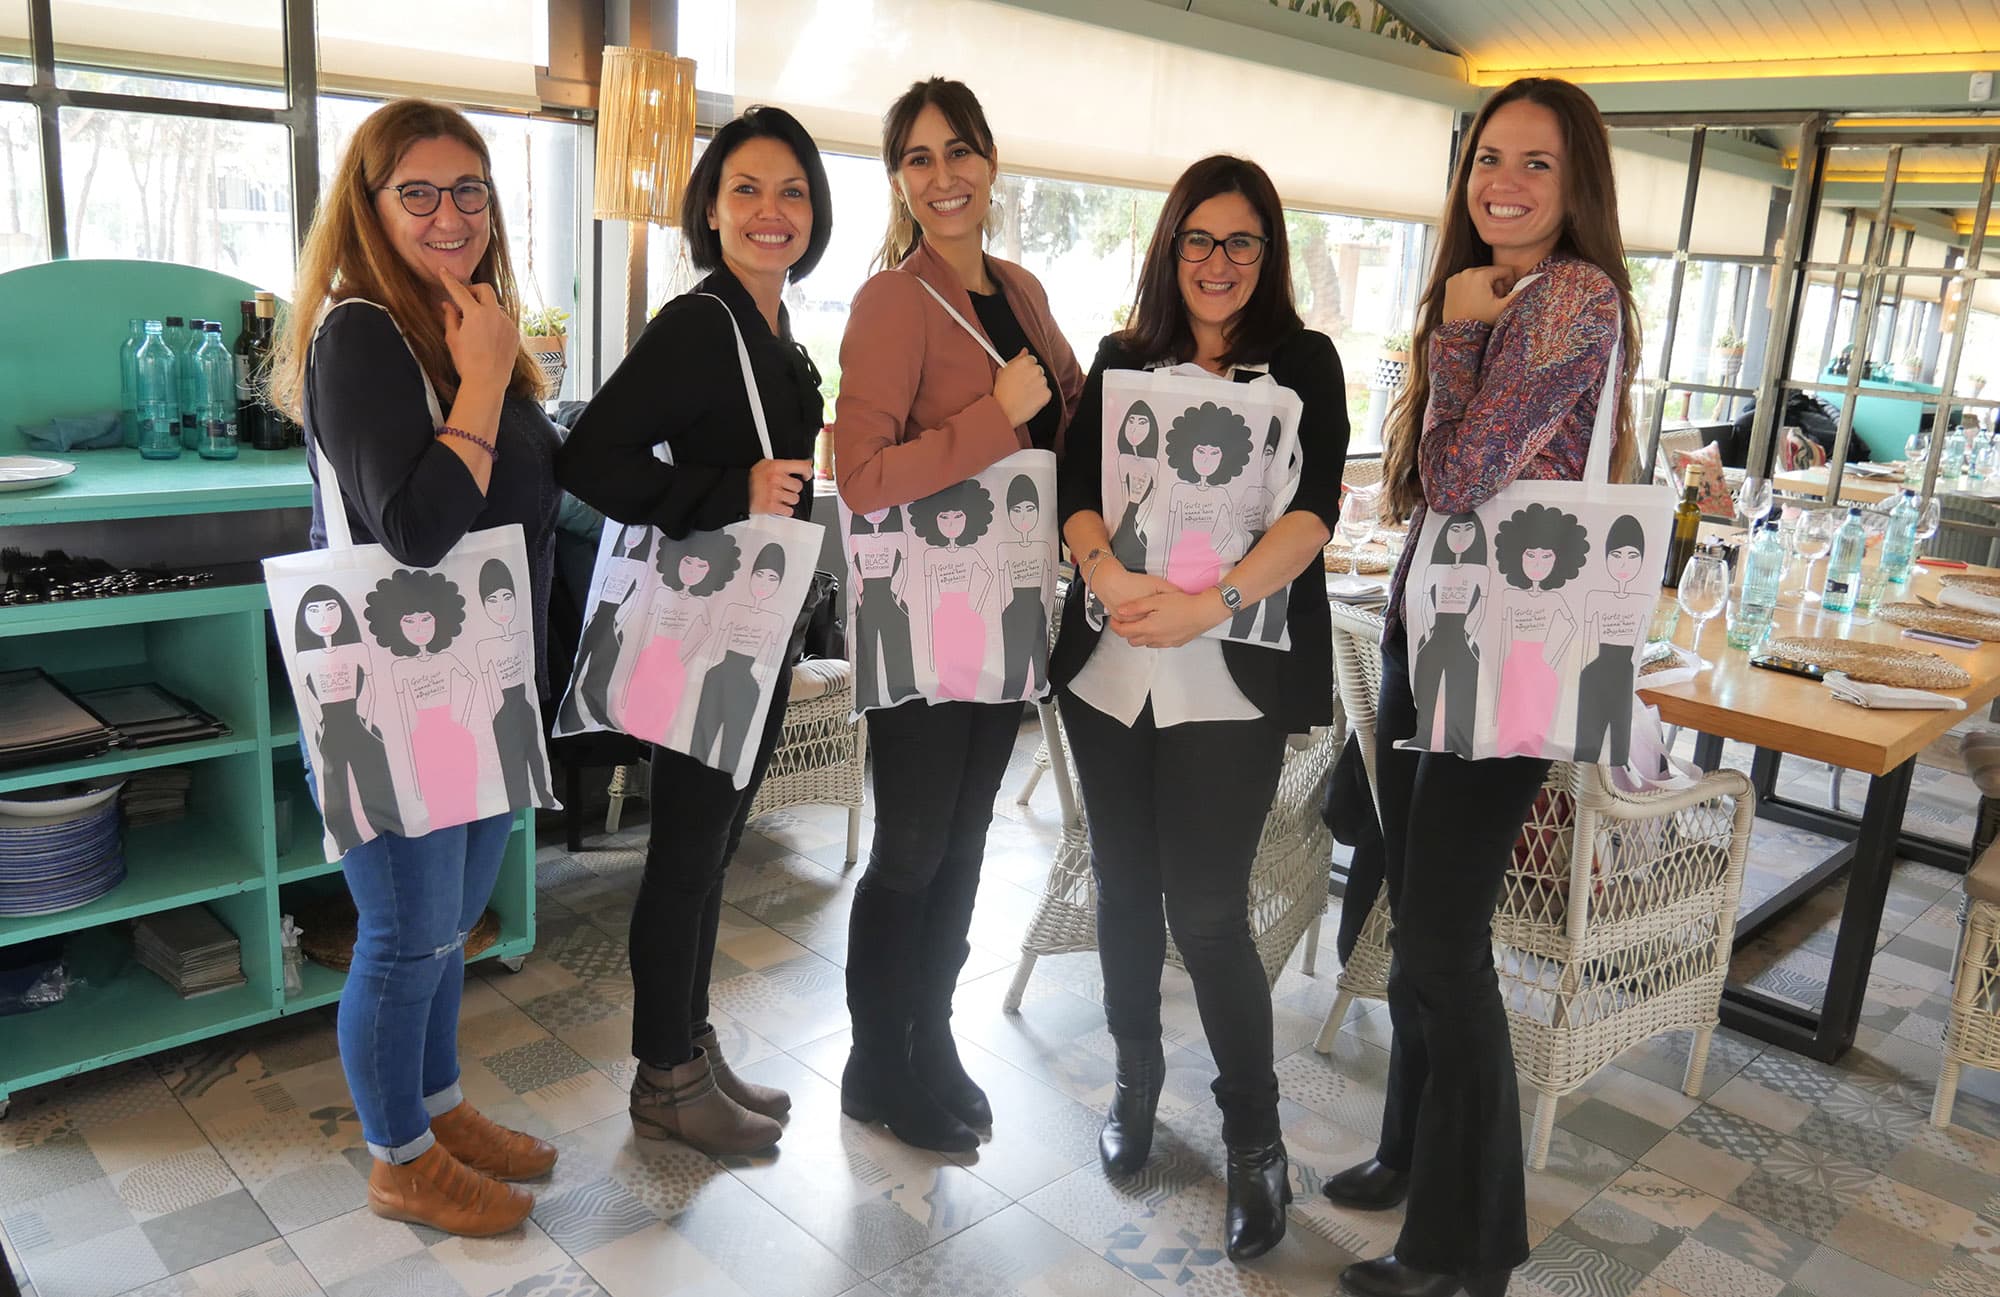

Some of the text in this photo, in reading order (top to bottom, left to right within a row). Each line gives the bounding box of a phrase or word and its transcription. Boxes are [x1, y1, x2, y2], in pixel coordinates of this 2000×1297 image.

[865, 557, 889, 567] BLACK
[1440, 591, 1466, 600] BLACK
[320, 677, 351, 689] BLACK
